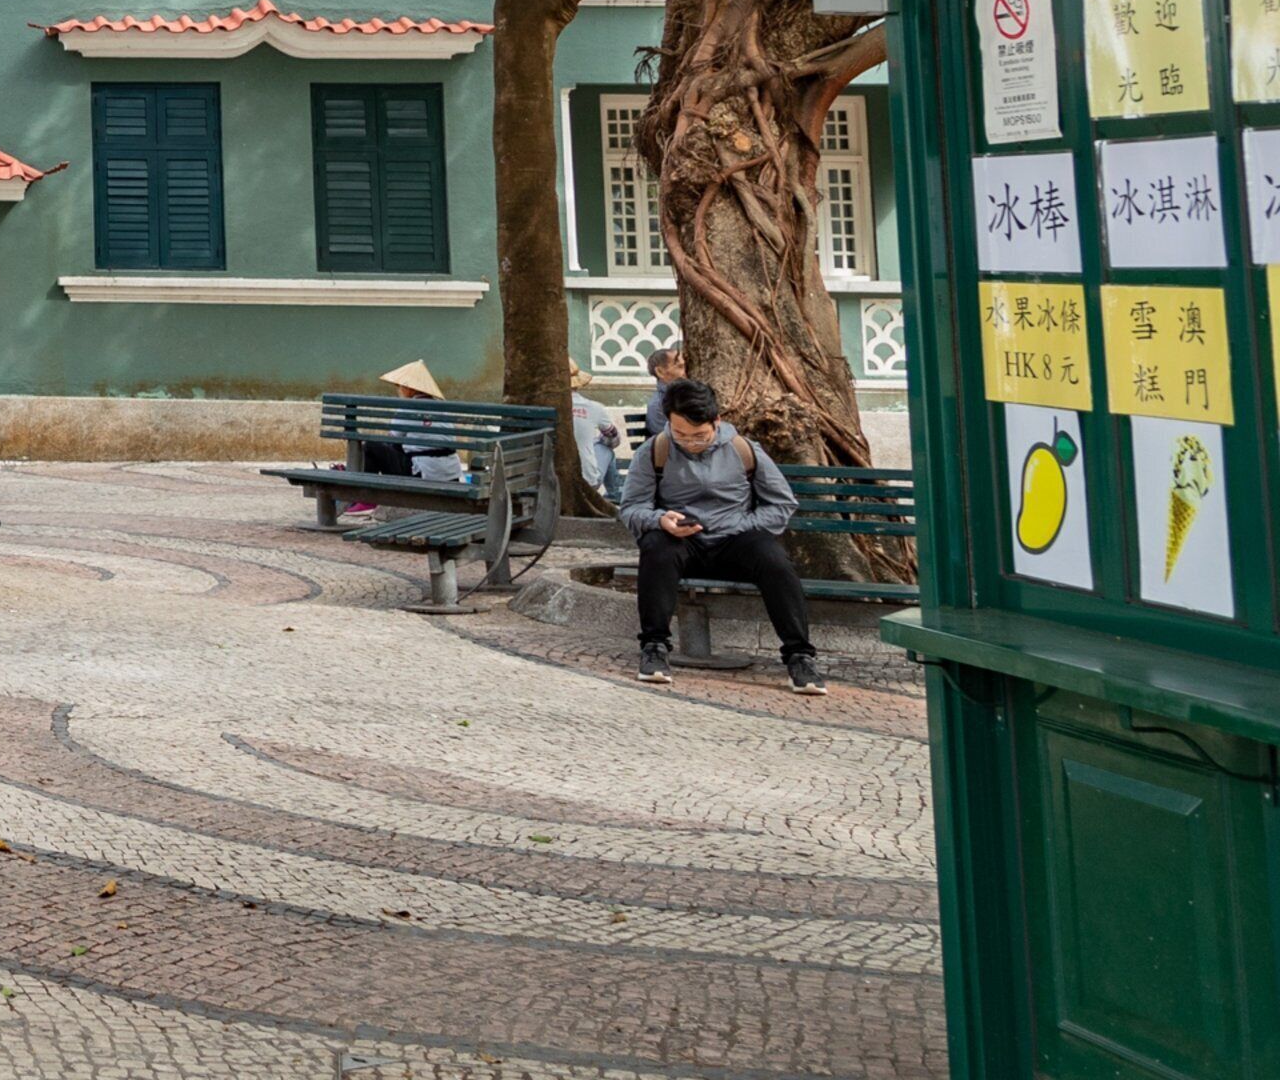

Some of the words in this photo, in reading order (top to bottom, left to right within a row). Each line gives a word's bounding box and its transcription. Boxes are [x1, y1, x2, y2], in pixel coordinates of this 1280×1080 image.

[1118, 64, 1184, 103] 光臨
[988, 180, 1070, 243] 冰棒
[1111, 174, 1218, 226] 冰淇淋
[985, 297, 1081, 335] 水果冰條
